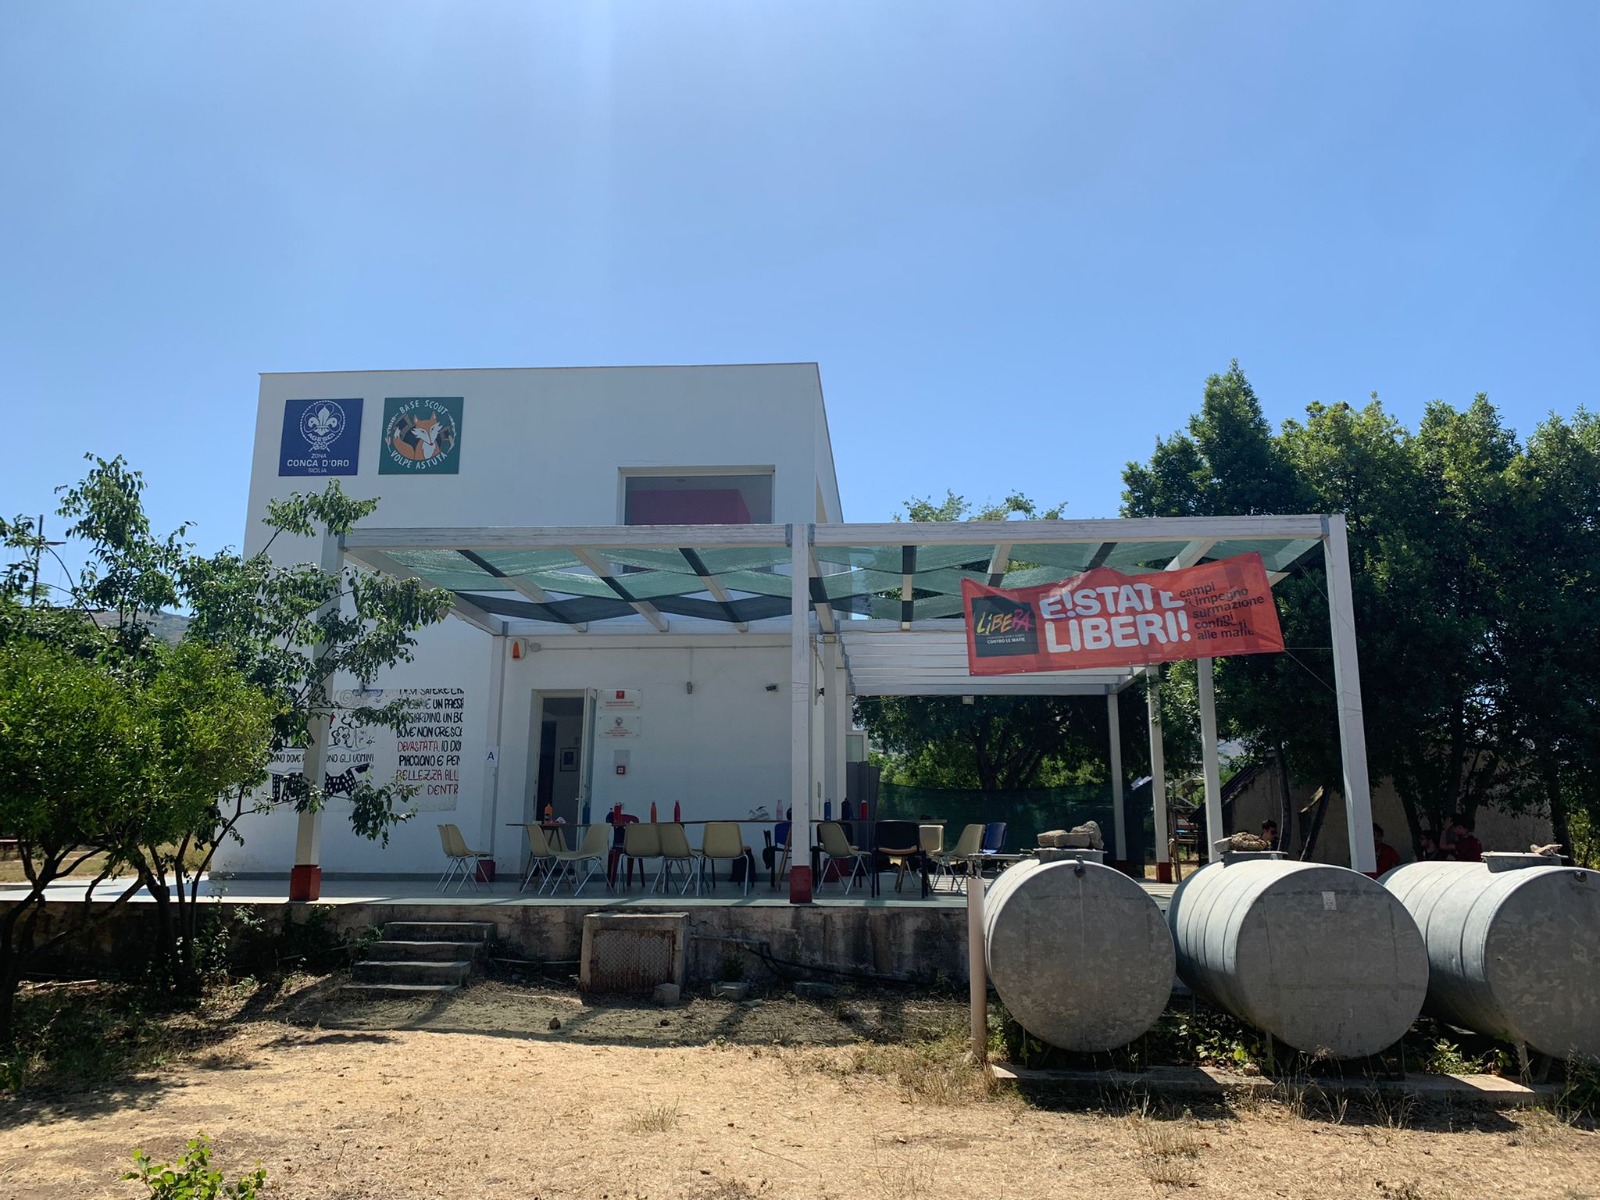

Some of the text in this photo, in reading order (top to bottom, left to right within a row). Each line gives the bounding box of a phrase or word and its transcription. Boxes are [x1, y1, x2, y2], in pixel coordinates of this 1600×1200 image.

[399, 399, 449, 415] BASE SCOUT
[287, 459, 349, 467] CONCA D'ORO
[390, 450, 448, 470] VOLPE ASTUTA
[1179, 581, 1216, 598] campi
[1195, 588, 1249, 606] impegno
[1044, 609, 1191, 654] LIBERI!
[1197, 629, 1218, 640] alle
[433, 698, 443, 709] UN
[417, 726, 433, 738] NON
[286, 753, 301, 763] DOVE
[352, 753, 374, 763] UOMINI
[486, 751, 495, 761] A
[396, 769, 442, 781] BELLEZZA
